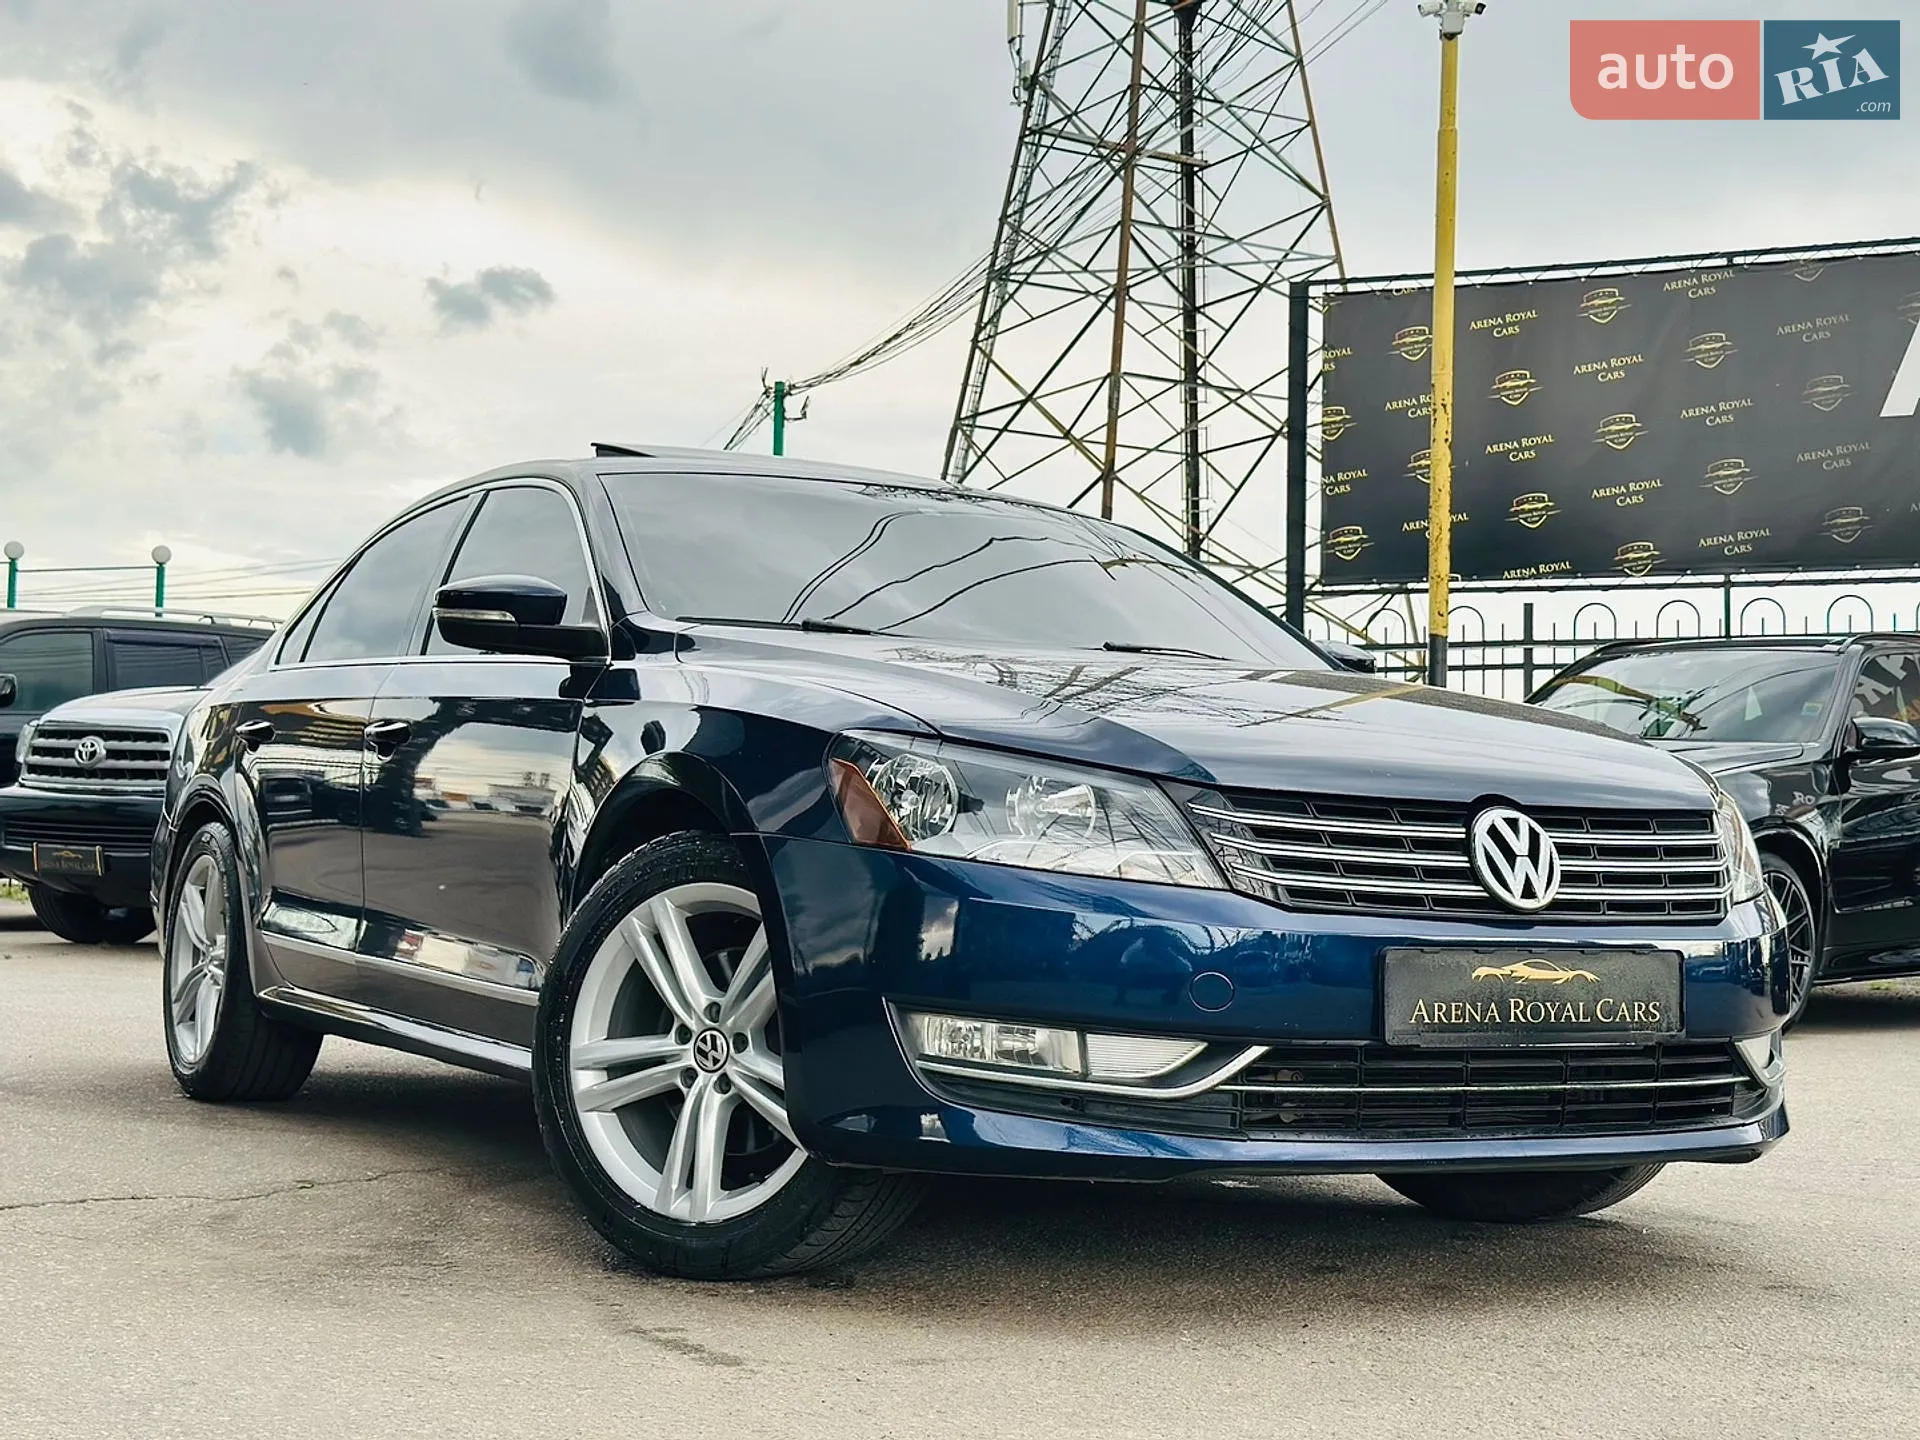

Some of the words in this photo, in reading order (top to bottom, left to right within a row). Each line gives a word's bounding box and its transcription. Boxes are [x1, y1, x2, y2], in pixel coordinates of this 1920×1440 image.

[1664, 278, 1698, 291] ARENA
[1701, 270, 1735, 283] ROYAL
[1688, 287, 1715, 298] CARS
[1470, 317, 1503, 331] ARENA
[1505, 310, 1537, 323] ROYAL
[1777, 322, 1813, 335] ARENA
[1816, 314, 1850, 328] ROYAL
[1493, 326, 1519, 337] CARS
[1803, 332, 1831, 342] CARS
[1574, 362, 1607, 375] ARENA
[1611, 354, 1643, 367] ROYAL
[1598, 370, 1625, 381] CARS
[1386, 398, 1417, 412] ARENA
[1681, 406, 1716, 419] ARENA
[1719, 399, 1753, 411] ROYAL
[1706, 414, 1733, 426] CARS
[1486, 441, 1519, 454] ARENA
[1522, 435, 1554, 447] ROYAL
[1509, 450, 1535, 461] CARS
[1797, 449, 1833, 462] ARENA
[1836, 442, 1871, 455] ROYAL
[1823, 458, 1851, 470] CARS
[1338, 469, 1368, 481] ROYAL
[1326, 484, 1350, 495] CARS
[1592, 486, 1626, 498] ARENA
[1629, 479, 1663, 491] ROYAL
[1617, 495, 1643, 506] CARS
[1403, 520, 1430, 531] AREN
[1699, 535, 1734, 547] ARENA
[1737, 528, 1771, 541] ROYAL
[1724, 544, 1752, 555] CARS
[1503, 567, 1537, 579] ARENA
[1539, 561, 1571, 573] ROYAL
[1409, 999, 1501, 1023] ARENA
[1509, 998, 1590, 1022] ROYAL
[1597, 998, 1660, 1022] CARS
